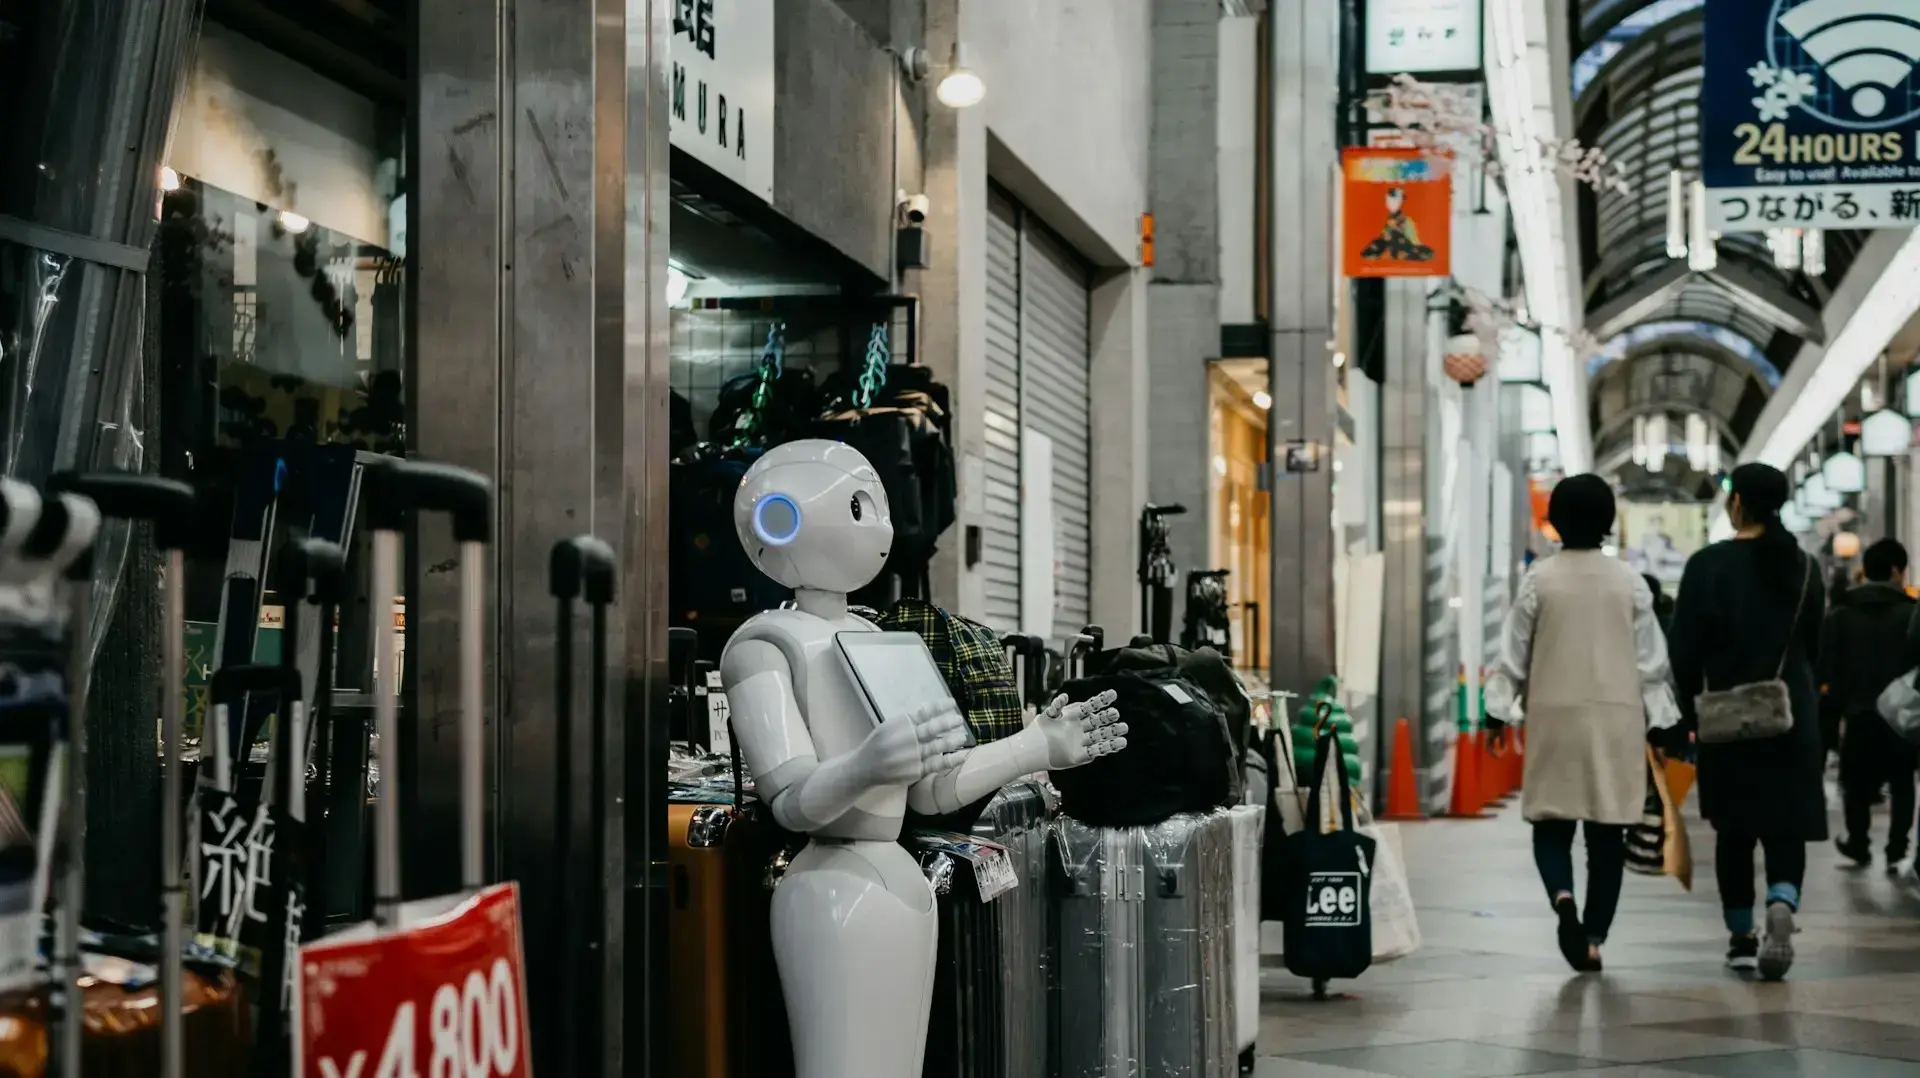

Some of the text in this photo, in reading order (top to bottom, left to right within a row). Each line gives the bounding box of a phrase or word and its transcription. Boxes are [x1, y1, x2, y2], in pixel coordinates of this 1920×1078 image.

[1754, 167, 1787, 183] Easy
[1788, 168, 1805, 181] to
[1841, 164, 1905, 178] Available
[1306, 885, 1356, 914] Lee
